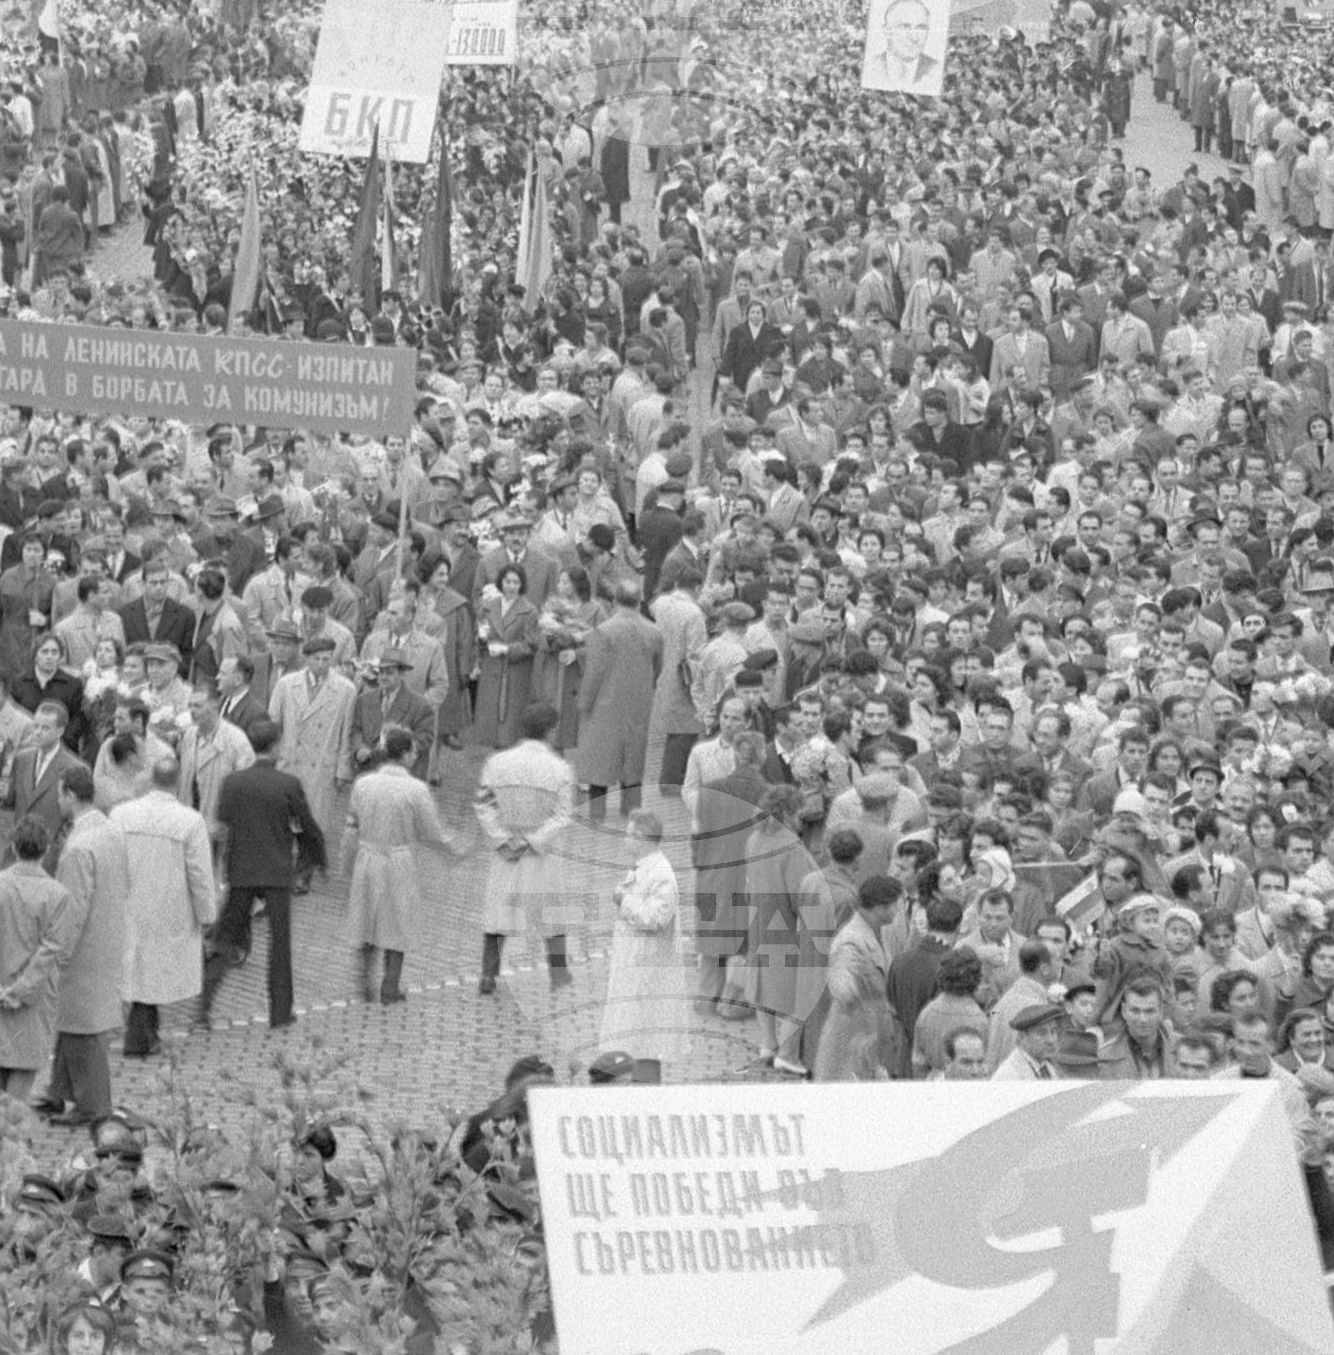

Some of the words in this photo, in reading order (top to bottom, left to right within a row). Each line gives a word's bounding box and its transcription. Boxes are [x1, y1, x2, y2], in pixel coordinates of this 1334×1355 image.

[324, 92, 415, 144] БКП
[21, 332, 49, 360] НА
[64, 336, 201, 373] ЛЕНИНСКАТА
[65, 372, 78, 397] В
[92, 375, 189, 407] БОРБАТА
[203, 384, 231, 410] ЗА
[558, 1113, 805, 1166] СОЦИАЛИЗМЪТ
[566, 1172, 617, 1222] ЩЕ
[629, 1170, 764, 1219] ПОБЕДИ
[574, 1223, 875, 1275] СЪРЕВНОВАНИЕТО
